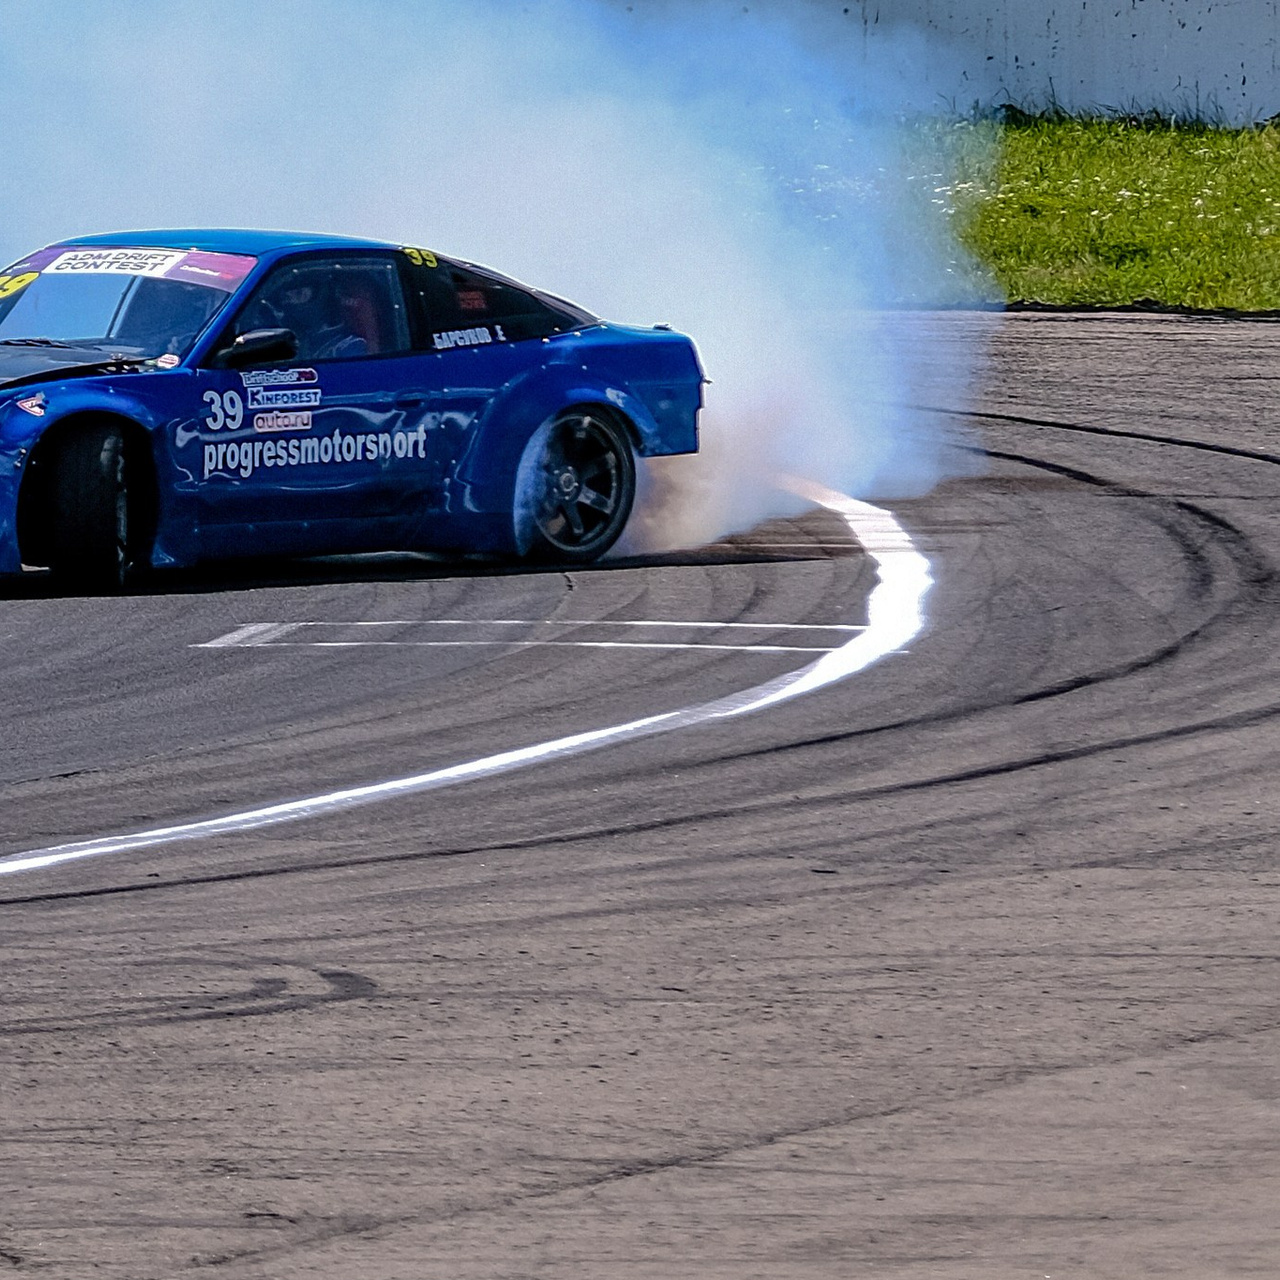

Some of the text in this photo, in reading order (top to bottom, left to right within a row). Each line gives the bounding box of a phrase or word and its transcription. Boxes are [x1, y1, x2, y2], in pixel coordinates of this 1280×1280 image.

[54, 261, 165, 271] CONTEST
[64, 252, 174, 262] ADM DRIFT
[402, 248, 438, 268] 39
[202, 390, 244, 430] 39
[203, 423, 426, 478] progressmotorsport
